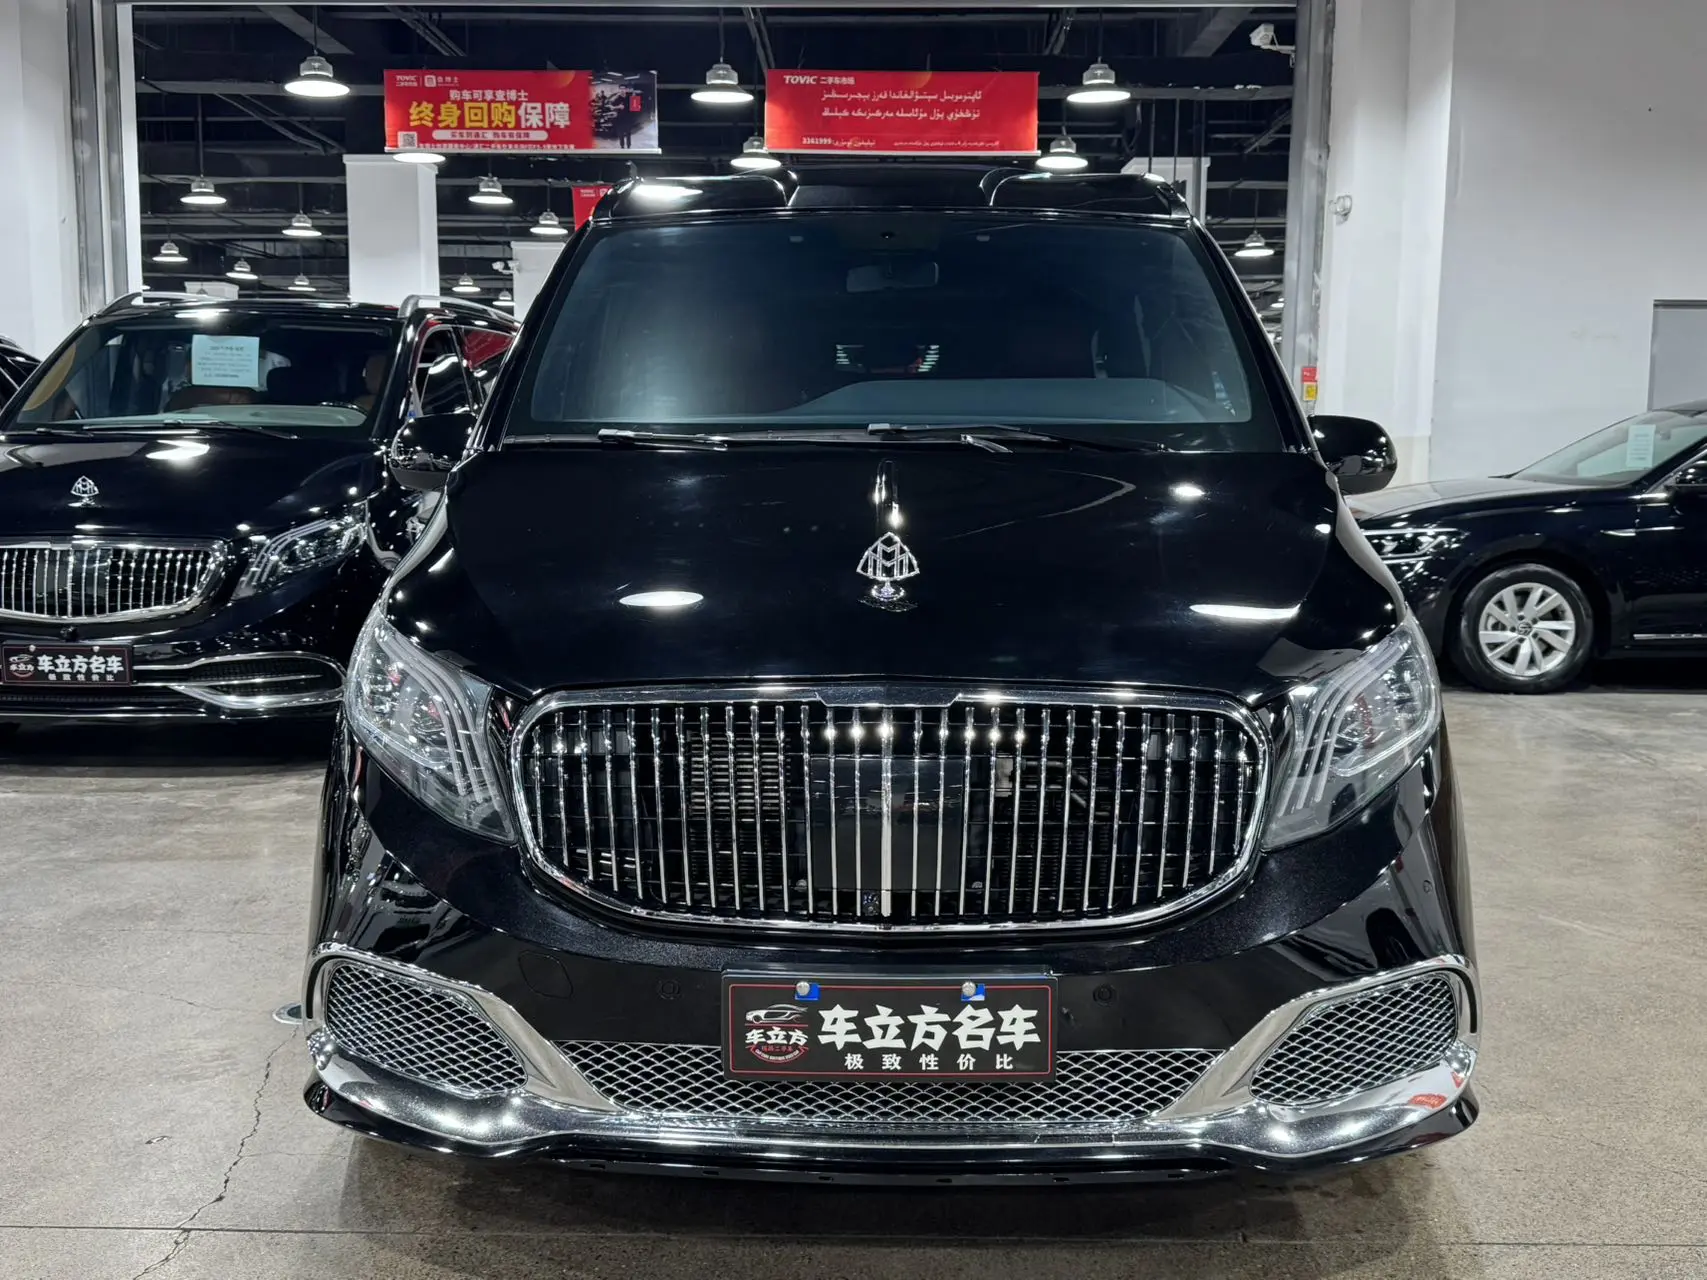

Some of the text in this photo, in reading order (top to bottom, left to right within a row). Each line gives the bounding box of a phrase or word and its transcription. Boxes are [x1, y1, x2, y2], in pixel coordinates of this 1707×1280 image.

[784, 75, 817, 84] TOVIC
[449, 89, 529, 101] 购车可享查博士
[409, 101, 571, 129] 终身回购保障
[37, 654, 124, 674] 车立方名车
[745, 1026, 808, 1046] 车立方
[817, 1004, 1041, 1051] 车立方名车
[844, 1053, 1014, 1071] 极致性价比
